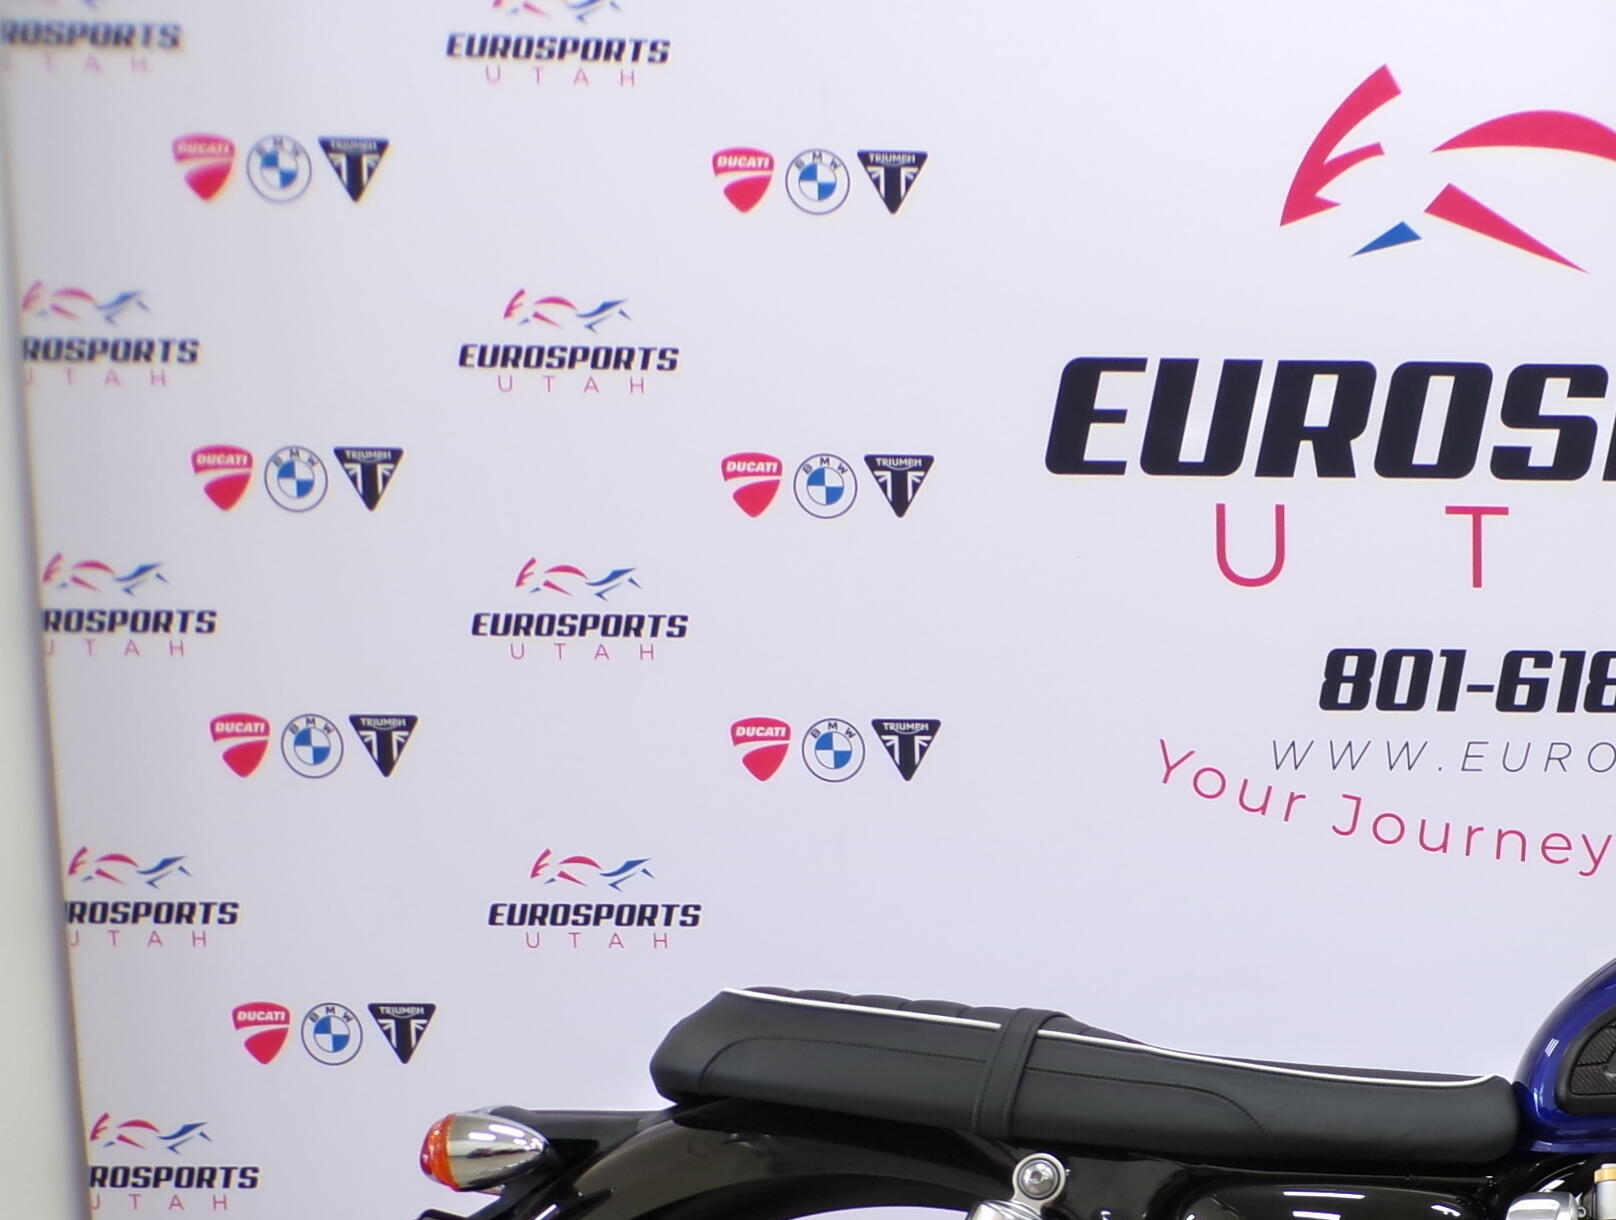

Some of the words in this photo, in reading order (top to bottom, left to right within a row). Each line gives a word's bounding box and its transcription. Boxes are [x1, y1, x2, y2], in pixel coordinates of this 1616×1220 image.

[0, 20, 183, 48] ROSPORTS
[446, 33, 671, 64] EUROSPORTS
[485, 66, 634, 87] UTAH
[177, 142, 230, 154] DUCATI
[717, 156, 769, 170] DUCATI
[793, 152, 841, 170] BMW
[869, 153, 916, 164] TRIUMPH
[22, 336, 199, 363] ROSPORTS
[458, 344, 679, 371] EUROSPORTS
[498, 375, 644, 394] UTAH
[196, 454, 248, 466] DUCATI
[273, 449, 318, 467] BMW
[345, 450, 392, 461] TRIUMPH
[876, 457, 923, 468] TRIUMPH
[726, 461, 778, 473] DUCATI
[802, 457, 848, 474] BMW
[43, 609, 217, 633] ROSPORTS
[471, 613, 689, 638] EUROSPORTS
[510, 643, 654, 660] UTAH
[215, 722, 265, 734] DUCATI
[289, 717, 334, 735] BMW
[360, 717, 406, 727] TRIUMPH
[810, 721, 856, 739] BMW
[883, 722, 929, 732] TRIUMPH
[735, 726, 786, 738] DUCATI
[1159, 738, 1307, 823] Your
[66, 901, 239, 925] ROSPORTS
[488, 903, 702, 927] EUROSPORTS
[525, 932, 668, 949] UTAH
[237, 1010, 285, 1022] DUCATI
[309, 1006, 354, 1023] BMW
[379, 1006, 424, 1016] TRIUMPH
[90, 1166, 260, 1189] ROSPORTS
